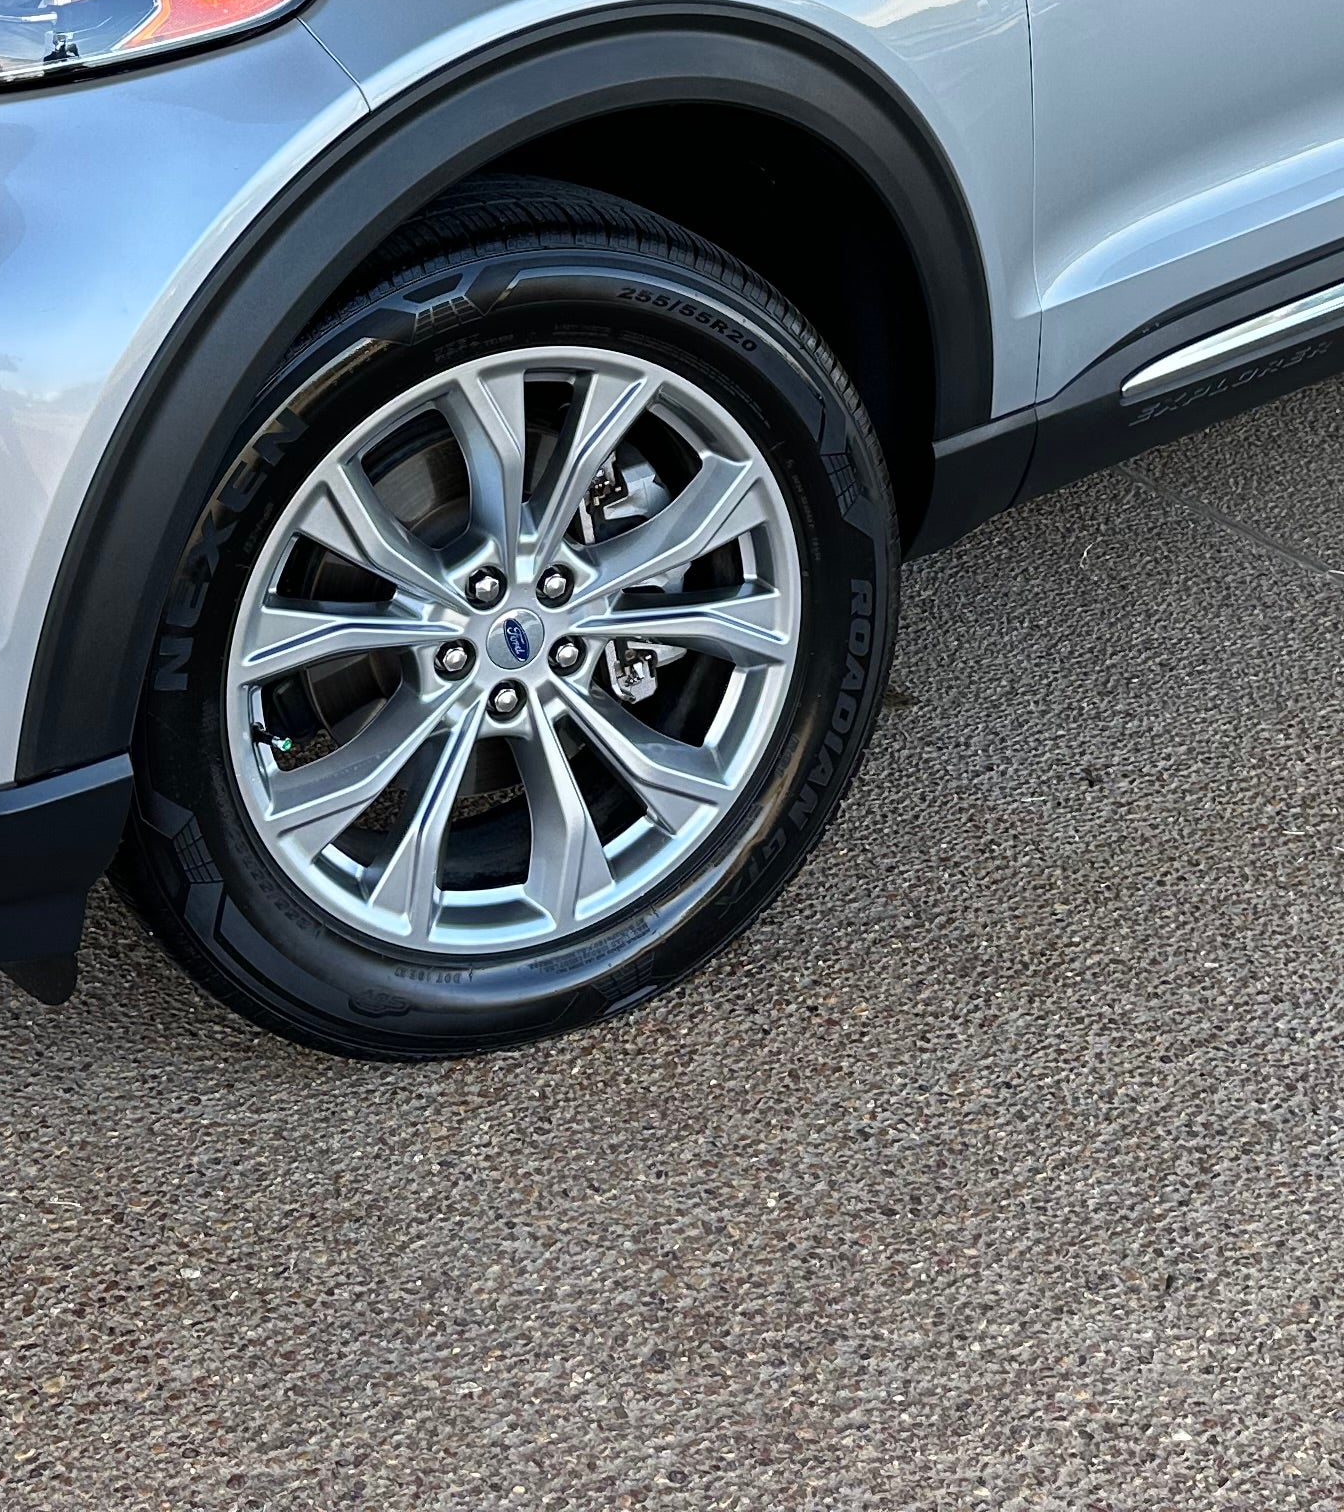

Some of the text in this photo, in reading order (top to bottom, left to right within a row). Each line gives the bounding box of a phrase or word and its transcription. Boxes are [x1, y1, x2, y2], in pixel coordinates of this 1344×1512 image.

[616, 286, 758, 353] 255/55R20
[1127, 339, 1334, 428] EXPLORER
[154, 406, 309, 691] NEXEN
[788, 577, 874, 836] ROADIAN
